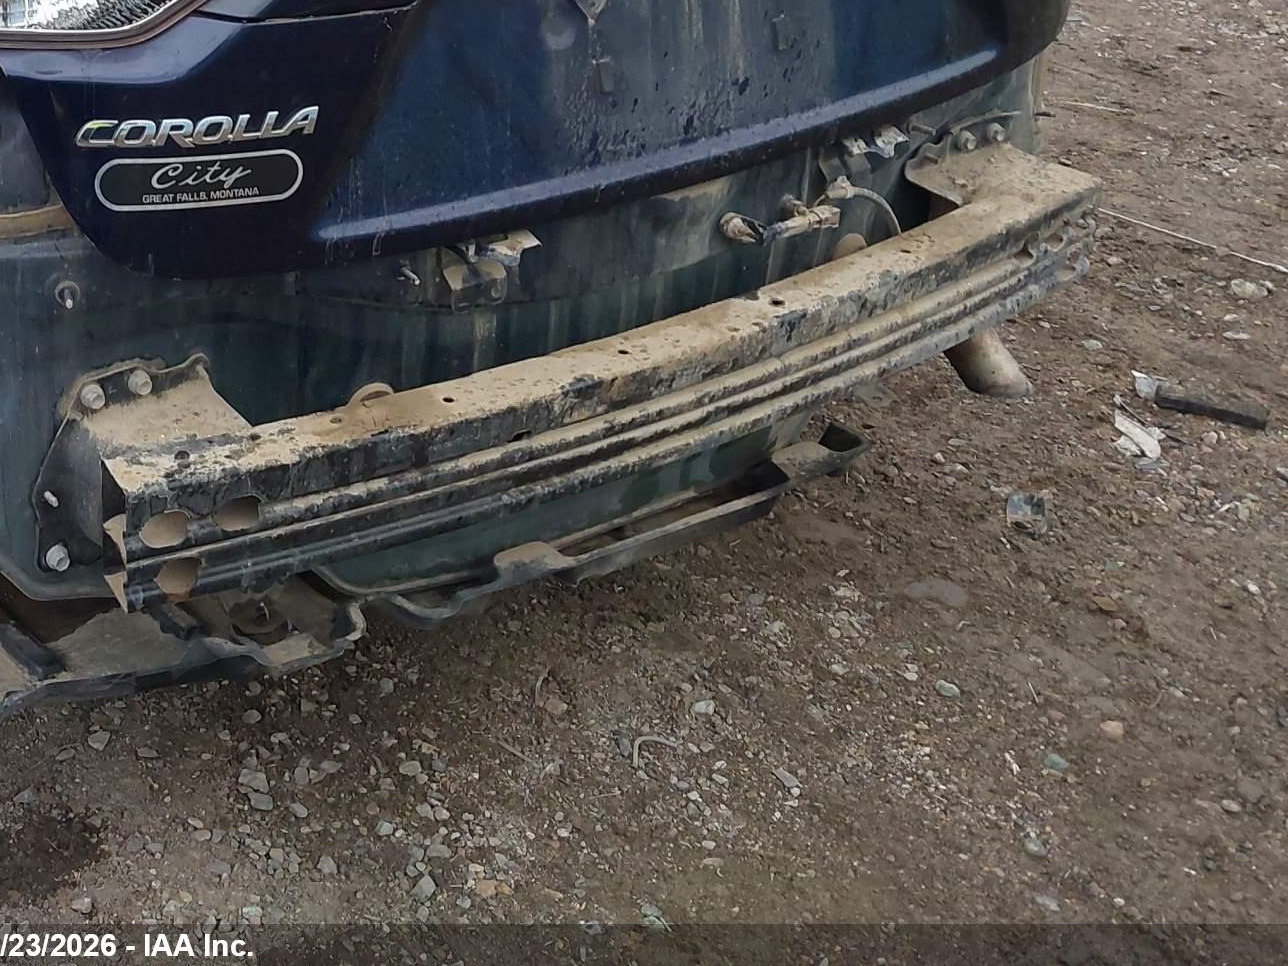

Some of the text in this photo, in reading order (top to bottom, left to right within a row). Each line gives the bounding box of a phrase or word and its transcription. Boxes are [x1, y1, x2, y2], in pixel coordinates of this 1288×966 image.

[76, 106, 319, 148] COROLLA
[151, 161, 252, 189] City
[142, 186, 260, 204] GREAT FALLS, MONTANA
